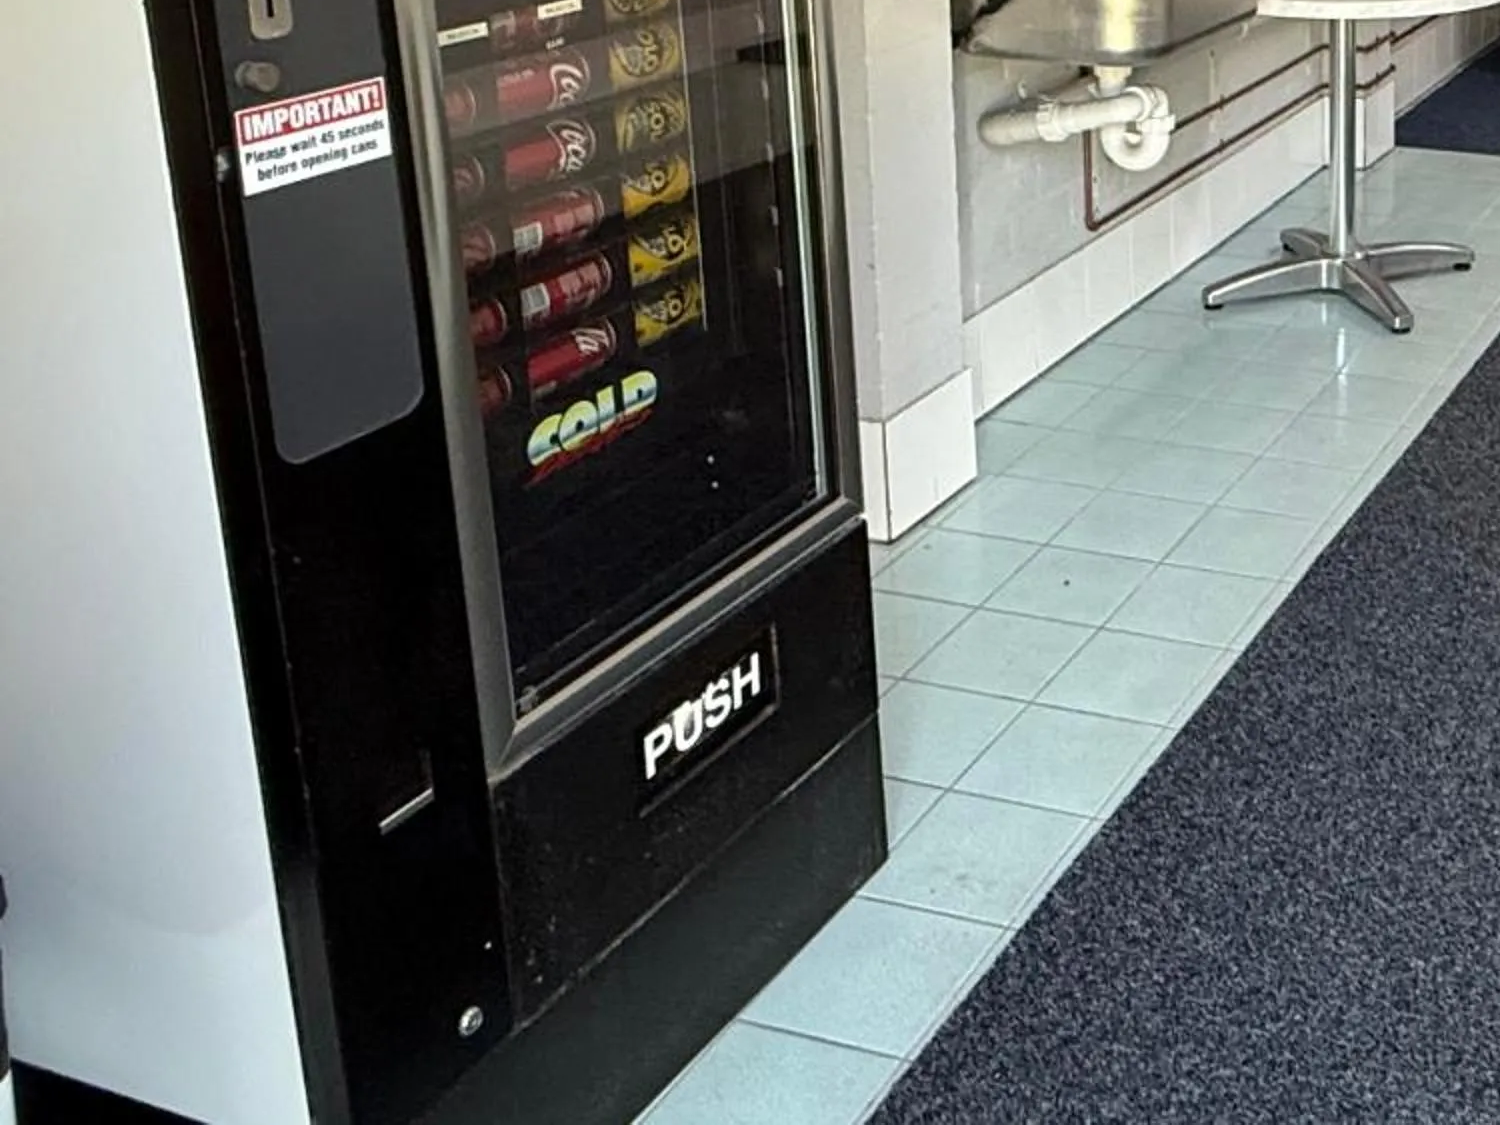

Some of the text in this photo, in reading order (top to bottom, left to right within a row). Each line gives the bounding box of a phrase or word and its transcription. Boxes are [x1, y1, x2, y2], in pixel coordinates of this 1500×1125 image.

[242, 85, 381, 142] IMPORTANT!
[245, 118, 385, 166] Please wait 45 seconds
[257, 138, 378, 182] before opening cans
[526, 370, 658, 469] COLD
[643, 651, 761, 780] PUSH
